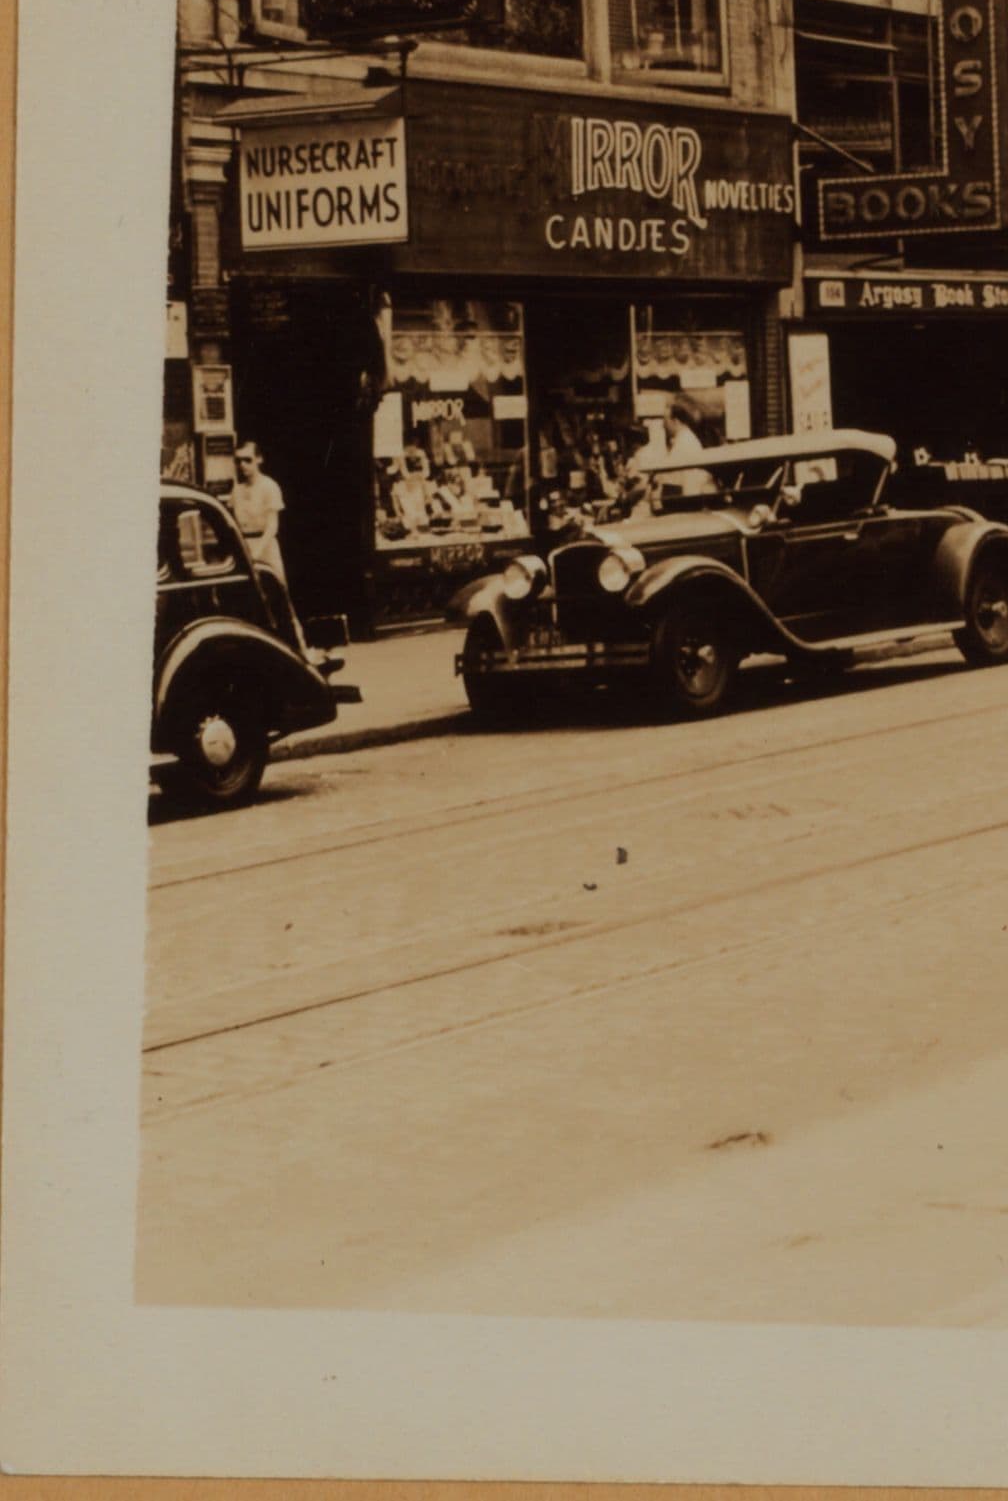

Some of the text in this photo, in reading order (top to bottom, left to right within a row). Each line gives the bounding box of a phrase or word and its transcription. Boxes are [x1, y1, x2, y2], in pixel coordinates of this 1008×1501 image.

[246, 136, 398, 178] NURSECRAFT
[247, 182, 401, 232] UNIFORMS
[703, 179, 795, 214] NOVELTIES
[824, 179, 993, 223] BOOKS
[545, 213, 690, 255] CANDIES
[859, 280, 923, 309] Argosy
[931, 282, 974, 308] Book
